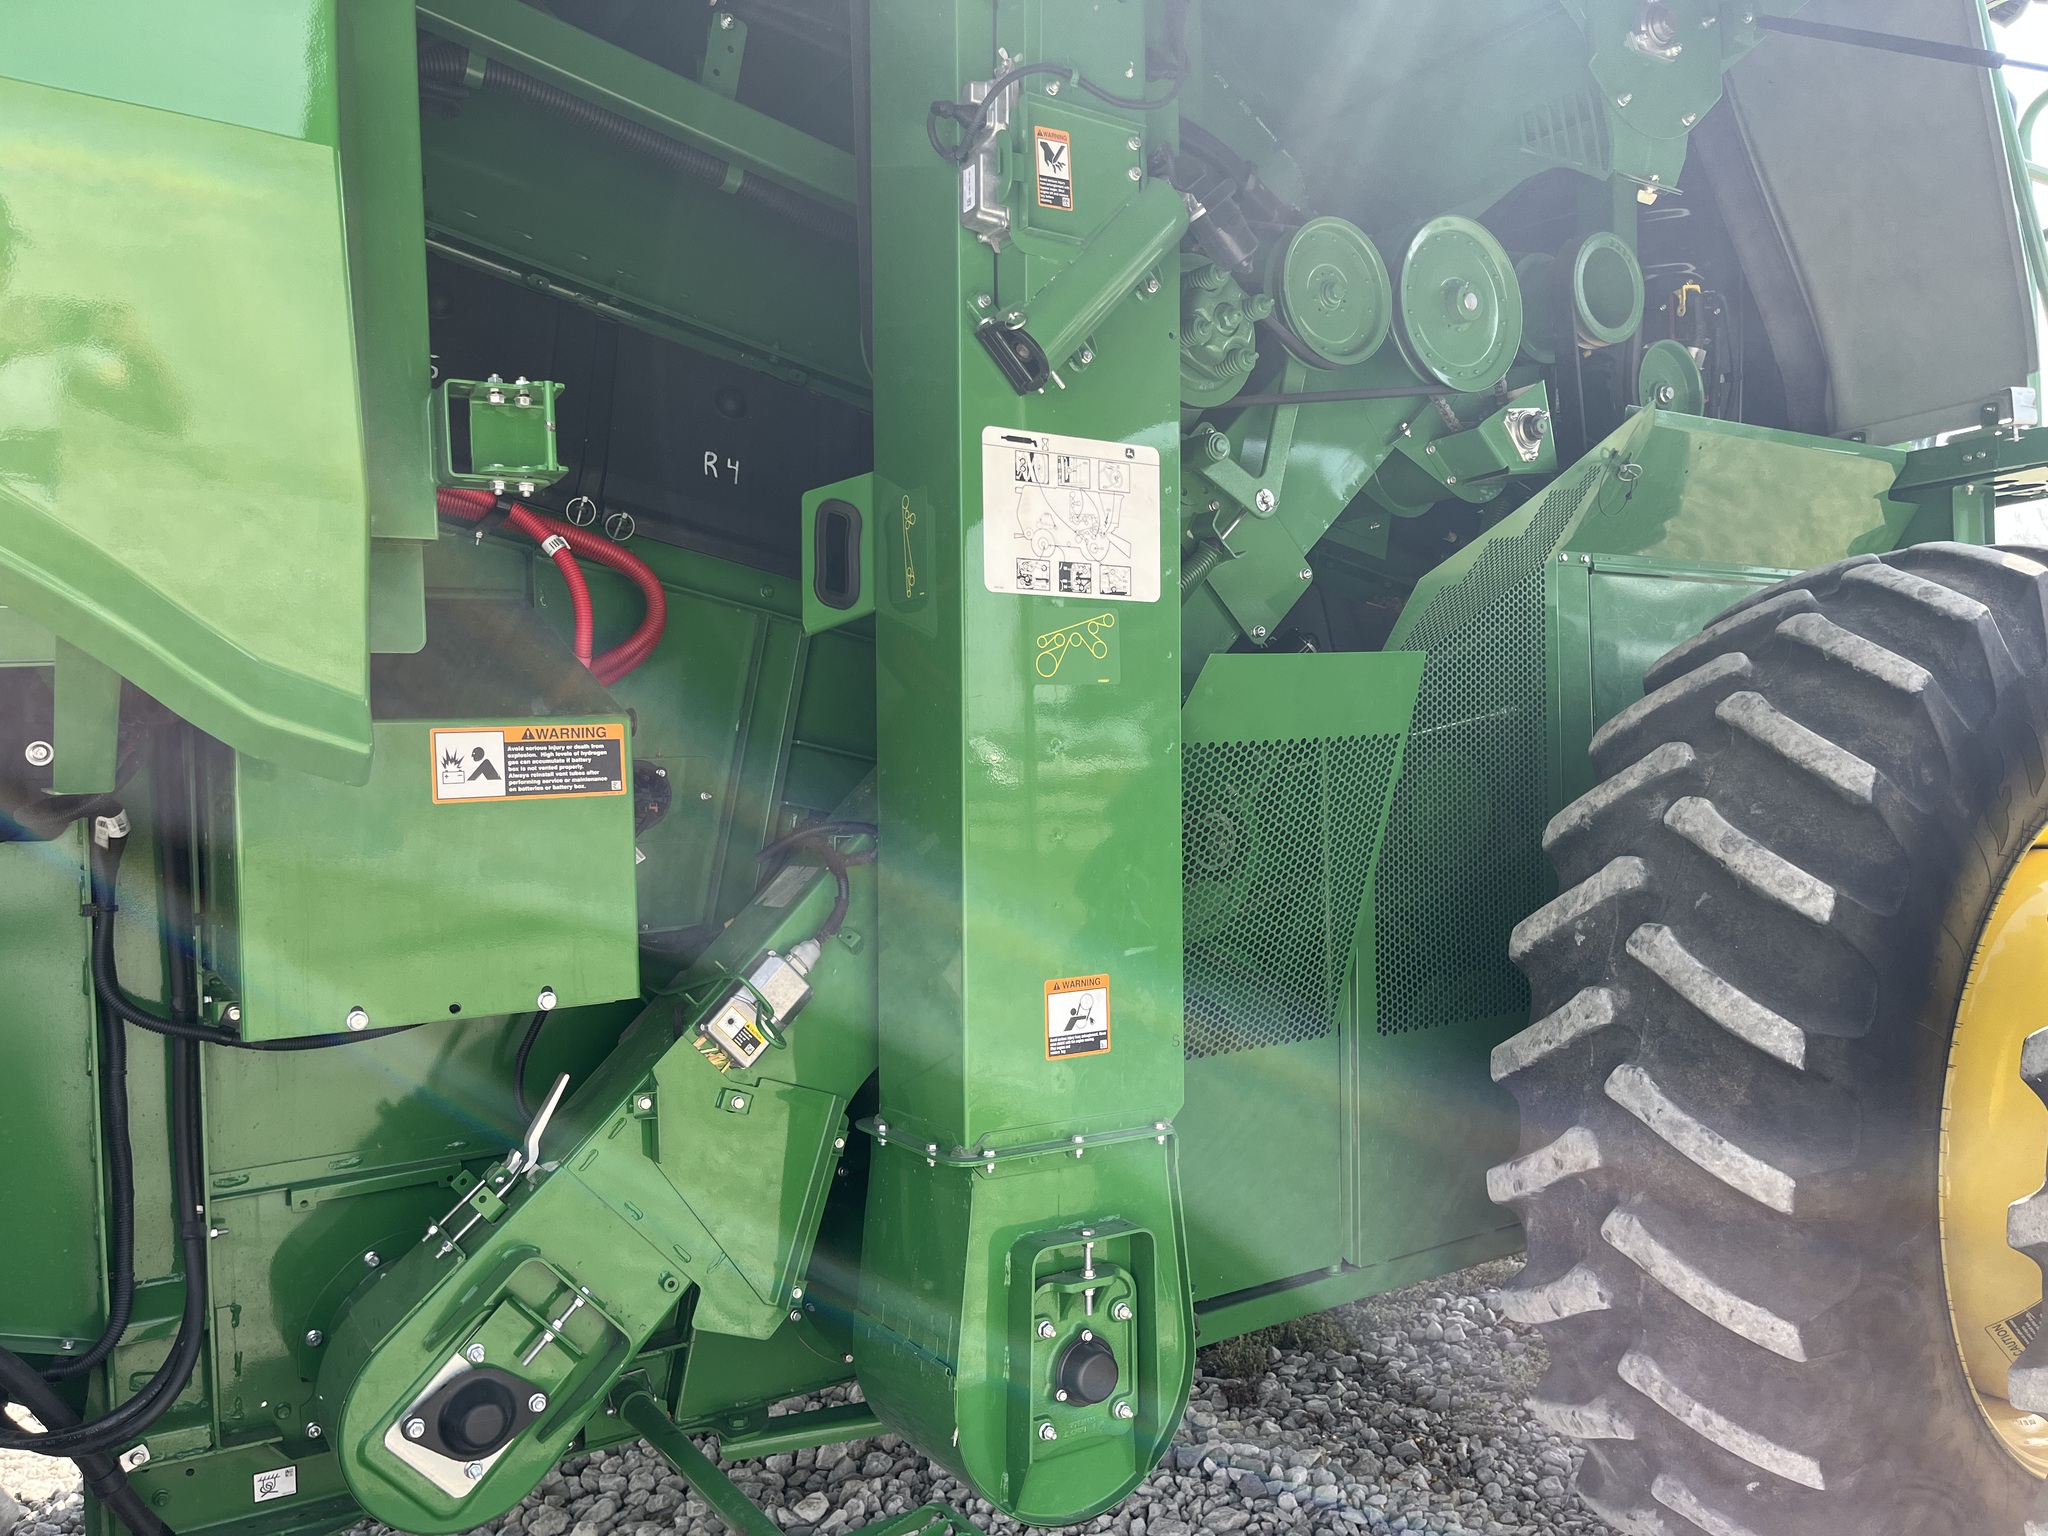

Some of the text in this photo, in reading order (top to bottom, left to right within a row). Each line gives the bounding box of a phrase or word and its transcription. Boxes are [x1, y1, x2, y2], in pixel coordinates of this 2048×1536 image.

[1043, 130, 1067, 141] WARNING
[536, 727, 606, 739] WARNING
[1062, 978, 1100, 989] WARNING
[1991, 1323, 2024, 1357] CAUTION
